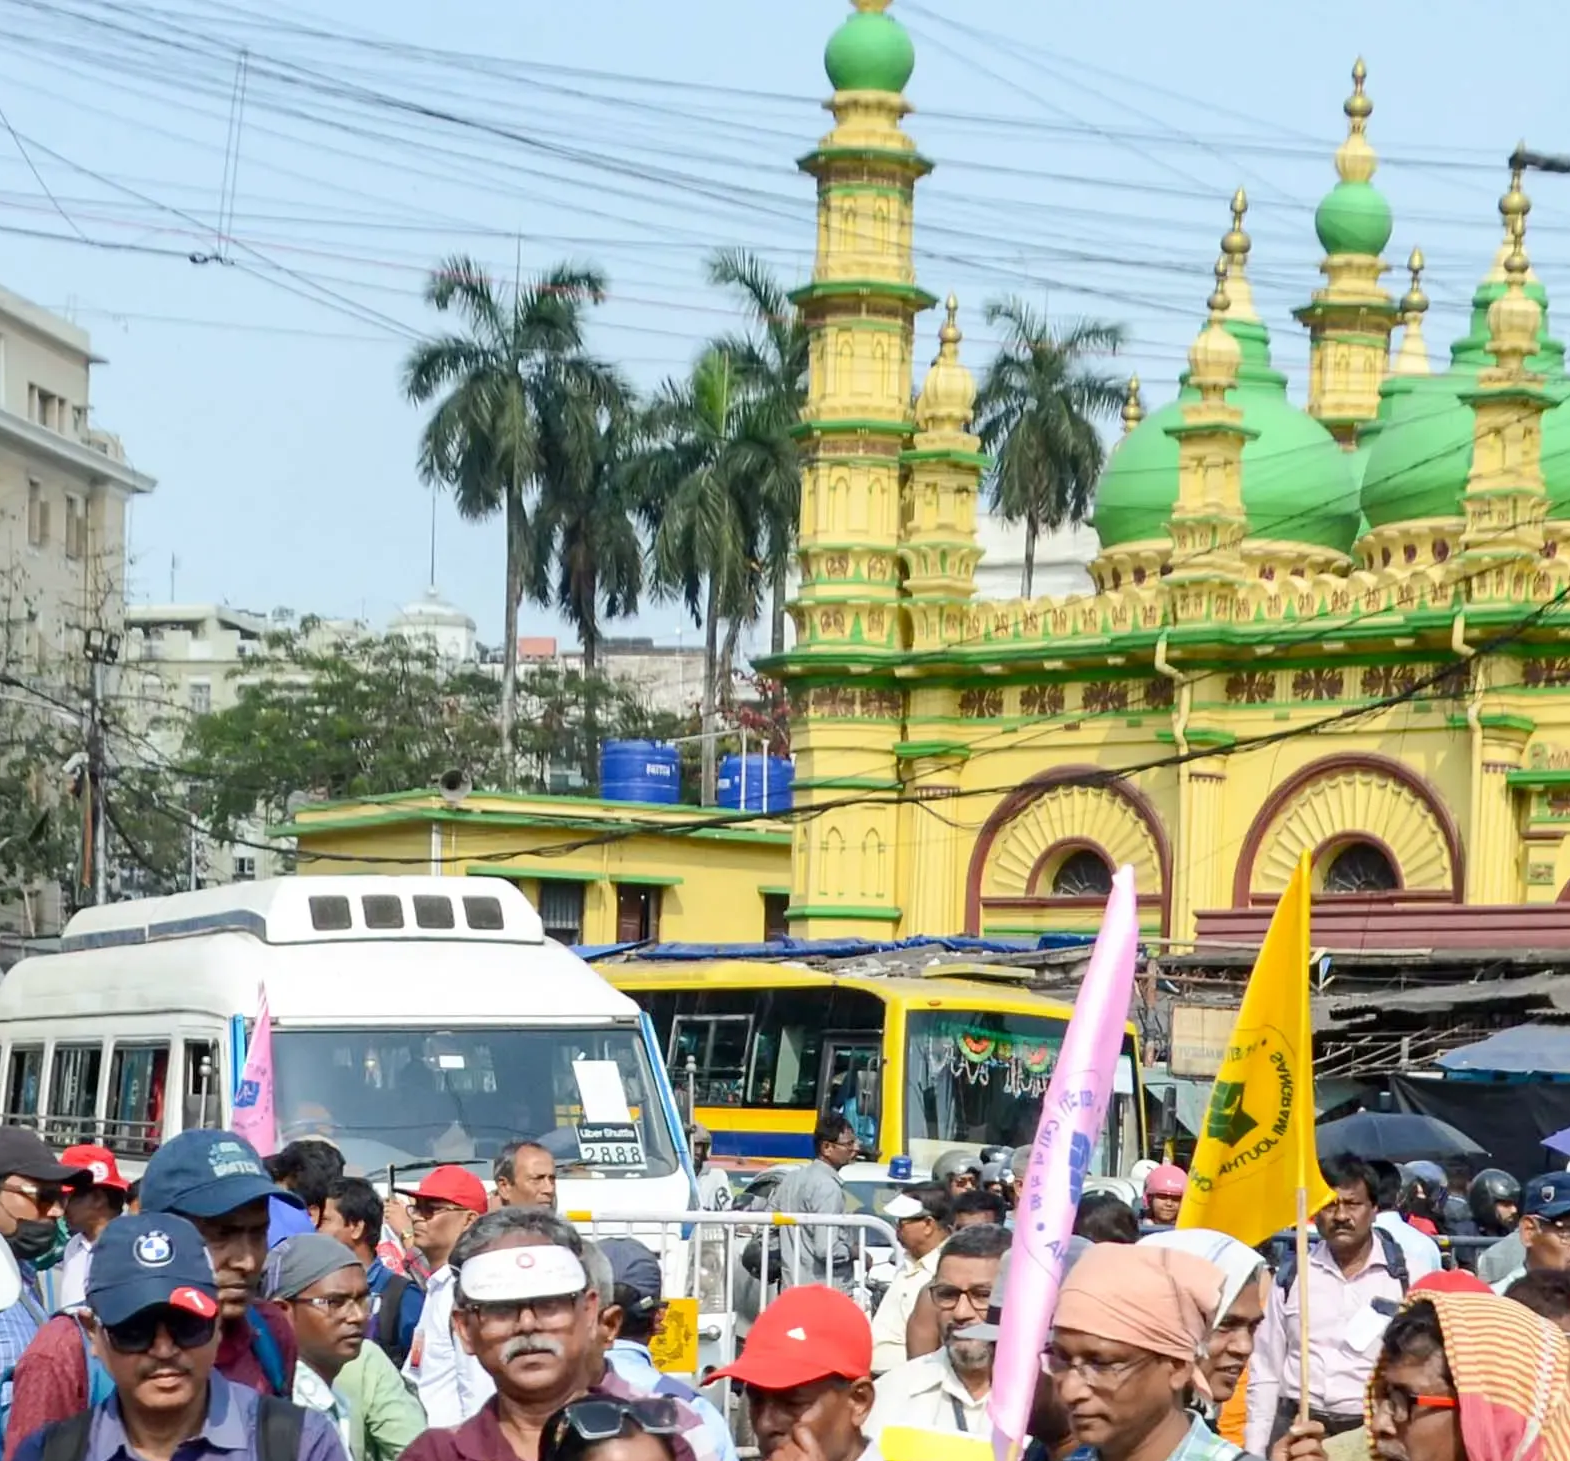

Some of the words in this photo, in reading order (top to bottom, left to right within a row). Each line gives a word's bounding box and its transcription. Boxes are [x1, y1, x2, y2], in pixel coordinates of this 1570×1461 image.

[579, 1128, 603, 1138] Uber
[604, 1127, 635, 1138] Shuttle
[584, 1146, 642, 1165] 2888
